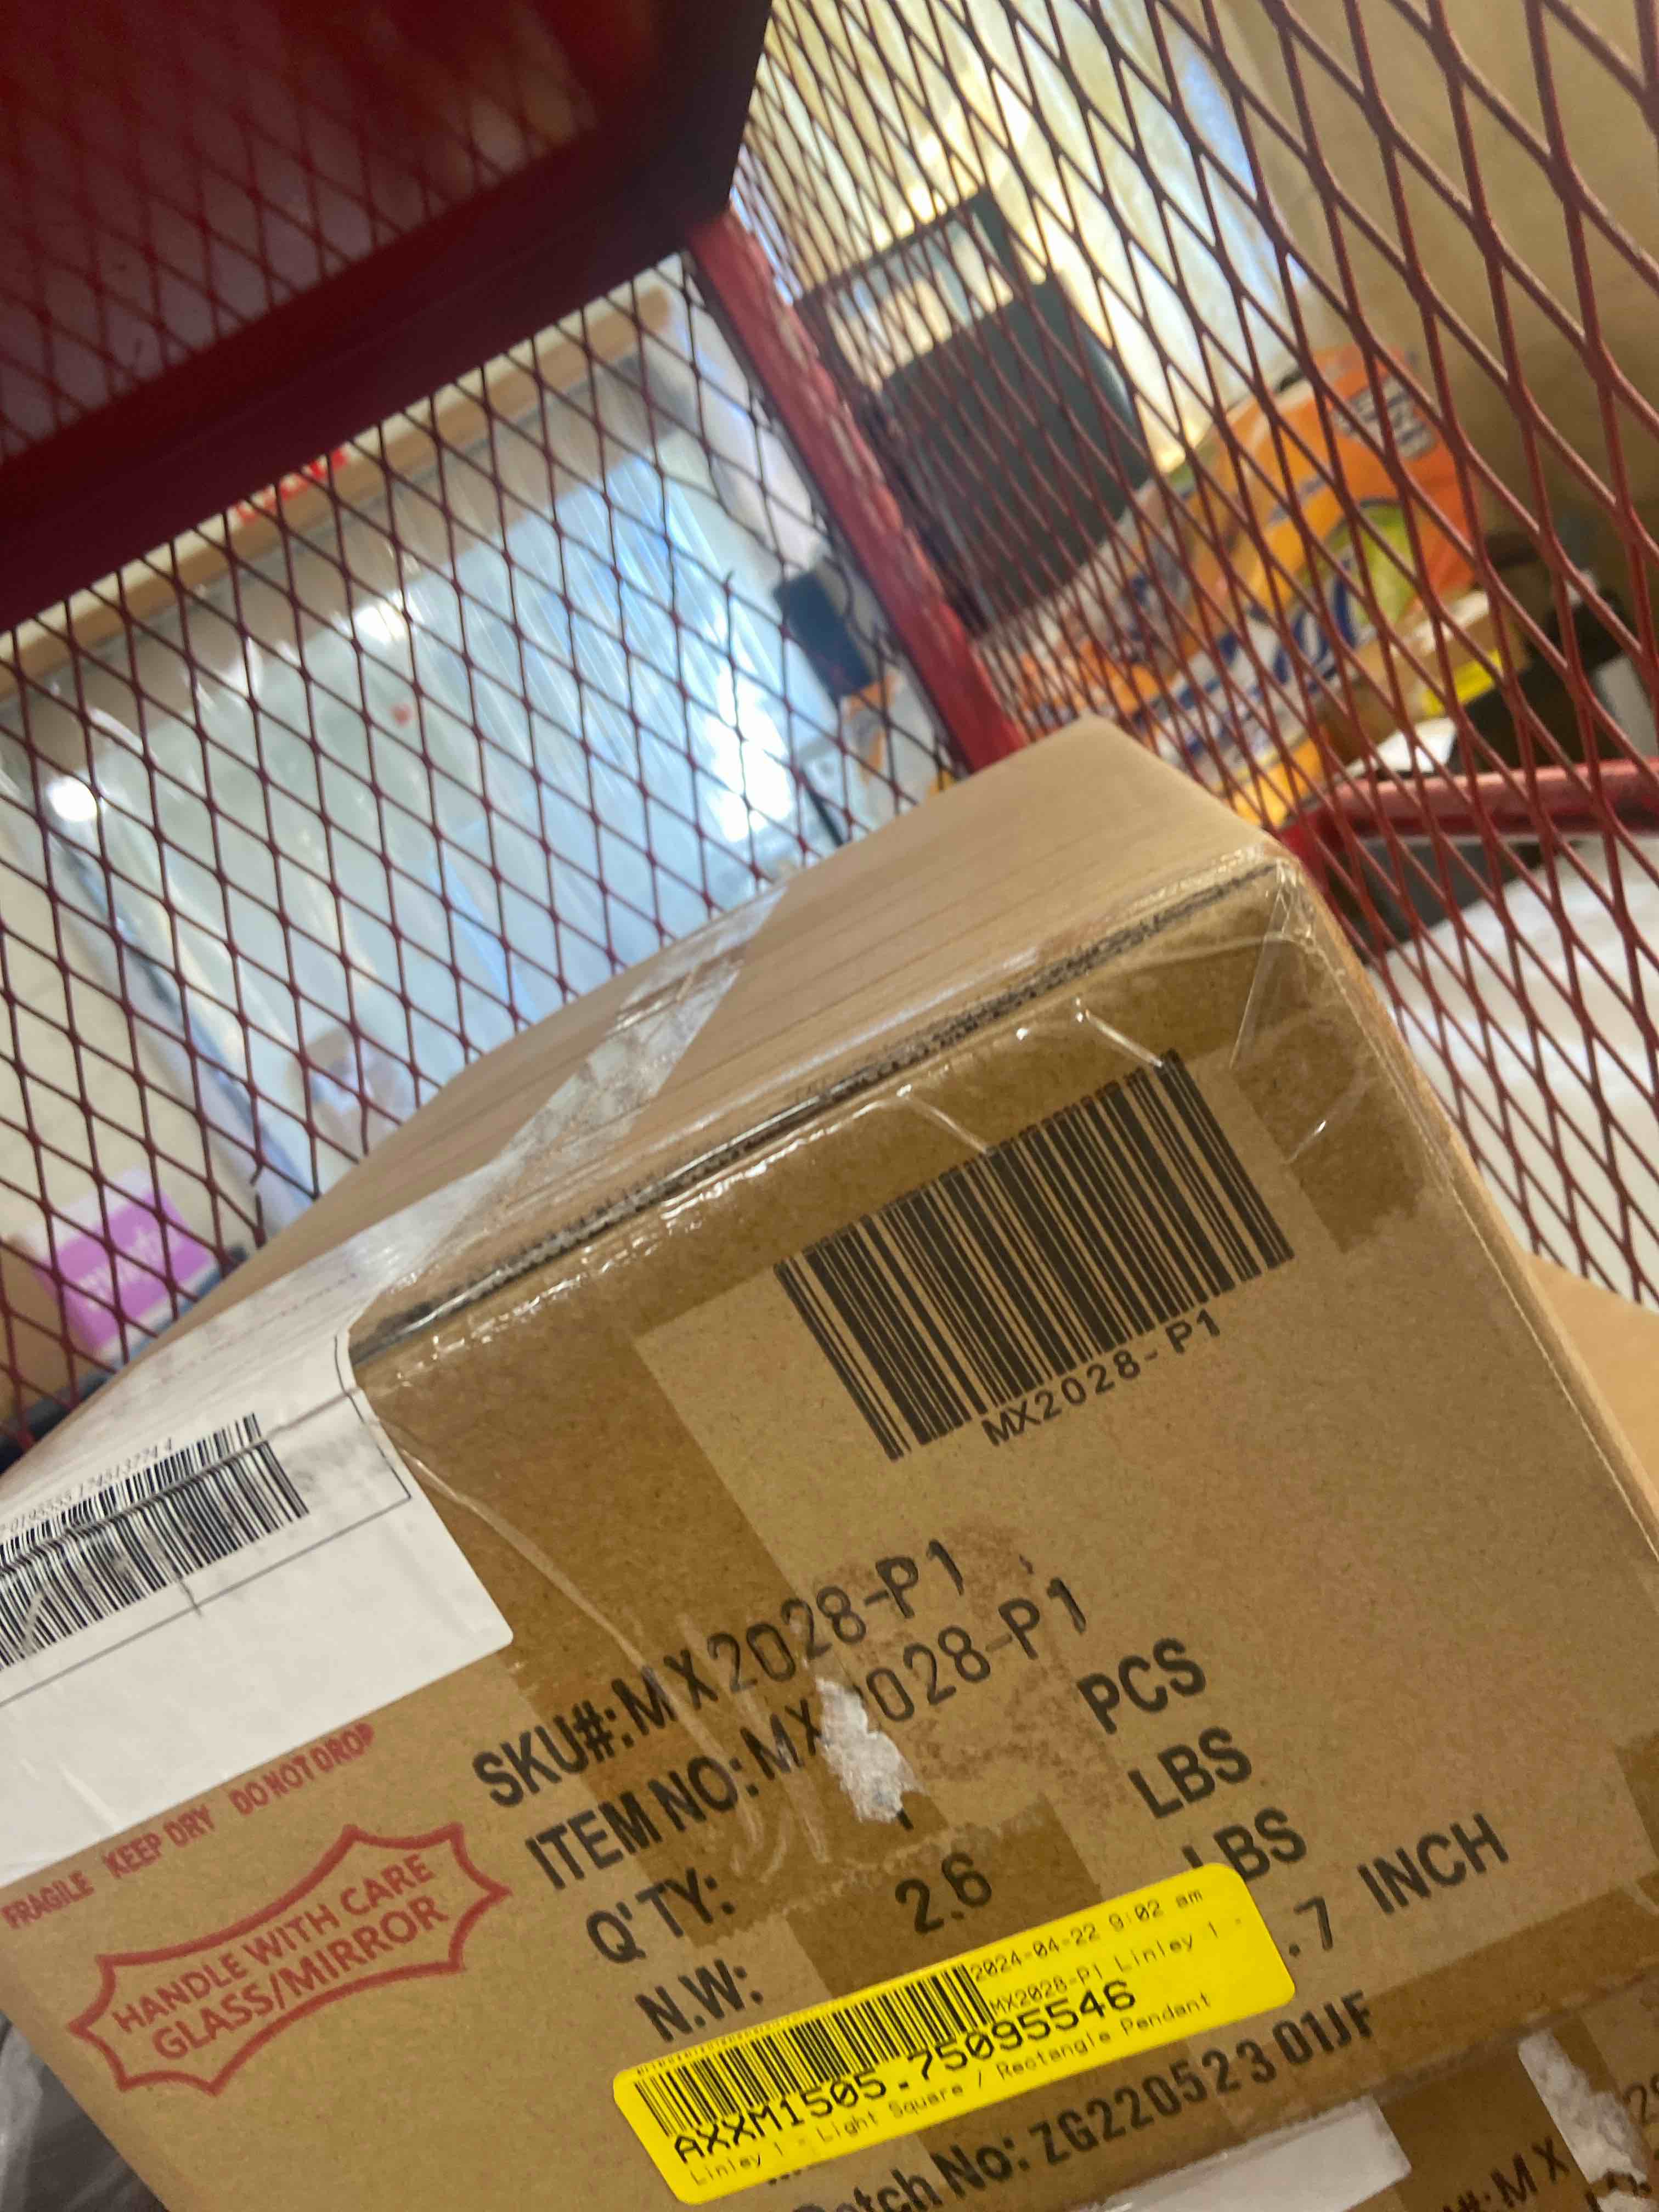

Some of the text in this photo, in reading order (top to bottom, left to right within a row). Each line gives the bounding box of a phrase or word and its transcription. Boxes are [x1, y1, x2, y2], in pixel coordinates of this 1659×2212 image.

[981, 1310, 1221, 1447] MX2028-P1
[1, 1870, 96, 1930] FRAGILE
[101, 1834, 163, 1881] KEEP
[163, 1804, 216, 1849] DRY
[229, 1781, 271, 1817] DO
[268, 1756, 319, 1802] NOT
[524, 1791, 663, 1891] ITEM
[586, 1637, 1206, 1963] Q'TY: PCS
[896, 1853, 992, 1934] 2.6
[1128, 1726, 1251, 1819] LBS
[1357, 1813, 1509, 1914] INCH
[112, 1853, 436, 2034] HANDLE WITH CARE
[151, 1895, 450, 2061] GLASS/MIRROR
[970, 1888, 1204, 1982] 2024-04-22 9:02 am
[989, 1963, 1103, 2016] MX2028-P1
[1114, 1933, 1193, 1974] Linley
[674, 1979, 1136, 2164] AXXM1505.75095546
[690, 2154, 761, 2186] Linley
[816, 2110, 879, 2141] Light
[888, 2083, 964, 2120] Square
[996, 2031, 1111, 2081] Rectangle
[1120, 1990, 1211, 2036] Pendant
[932, 2137, 1031, 2200] No:
